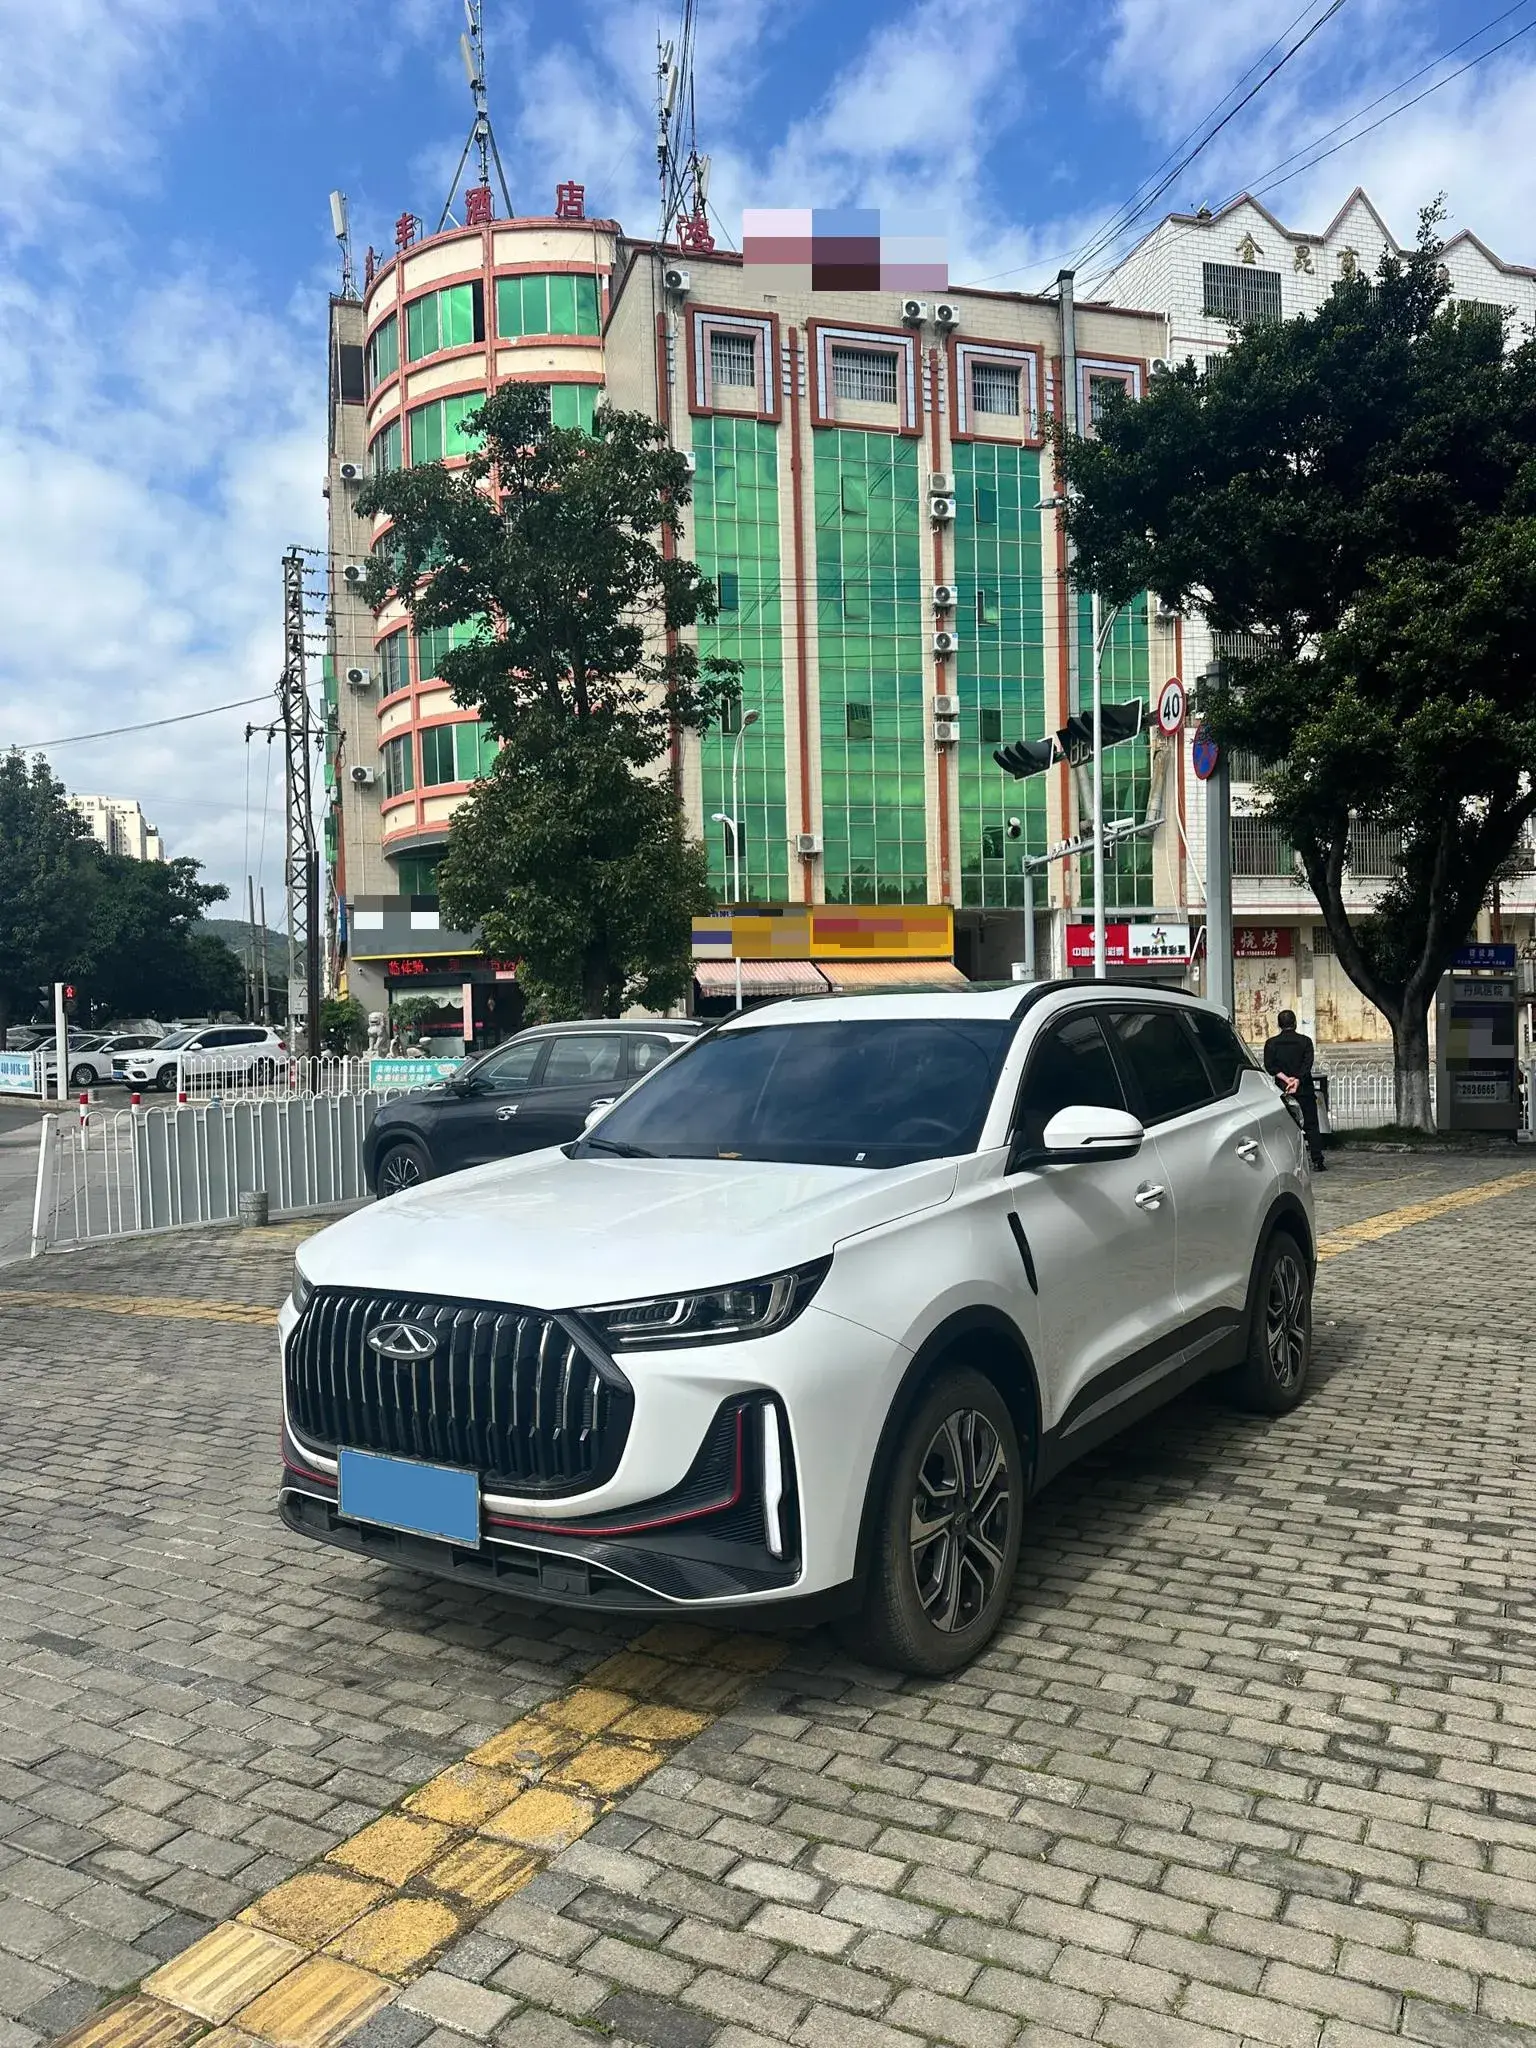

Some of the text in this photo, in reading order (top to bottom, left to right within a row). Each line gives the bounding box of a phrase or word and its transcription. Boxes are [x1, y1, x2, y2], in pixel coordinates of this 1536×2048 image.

[1163, 693, 1180, 721] 40
[1240, 929, 1279, 950] 烧烤
[1072, 946, 1124, 957] 中国彩票
[1133, 945, 1186, 956] 中国体育彩票
